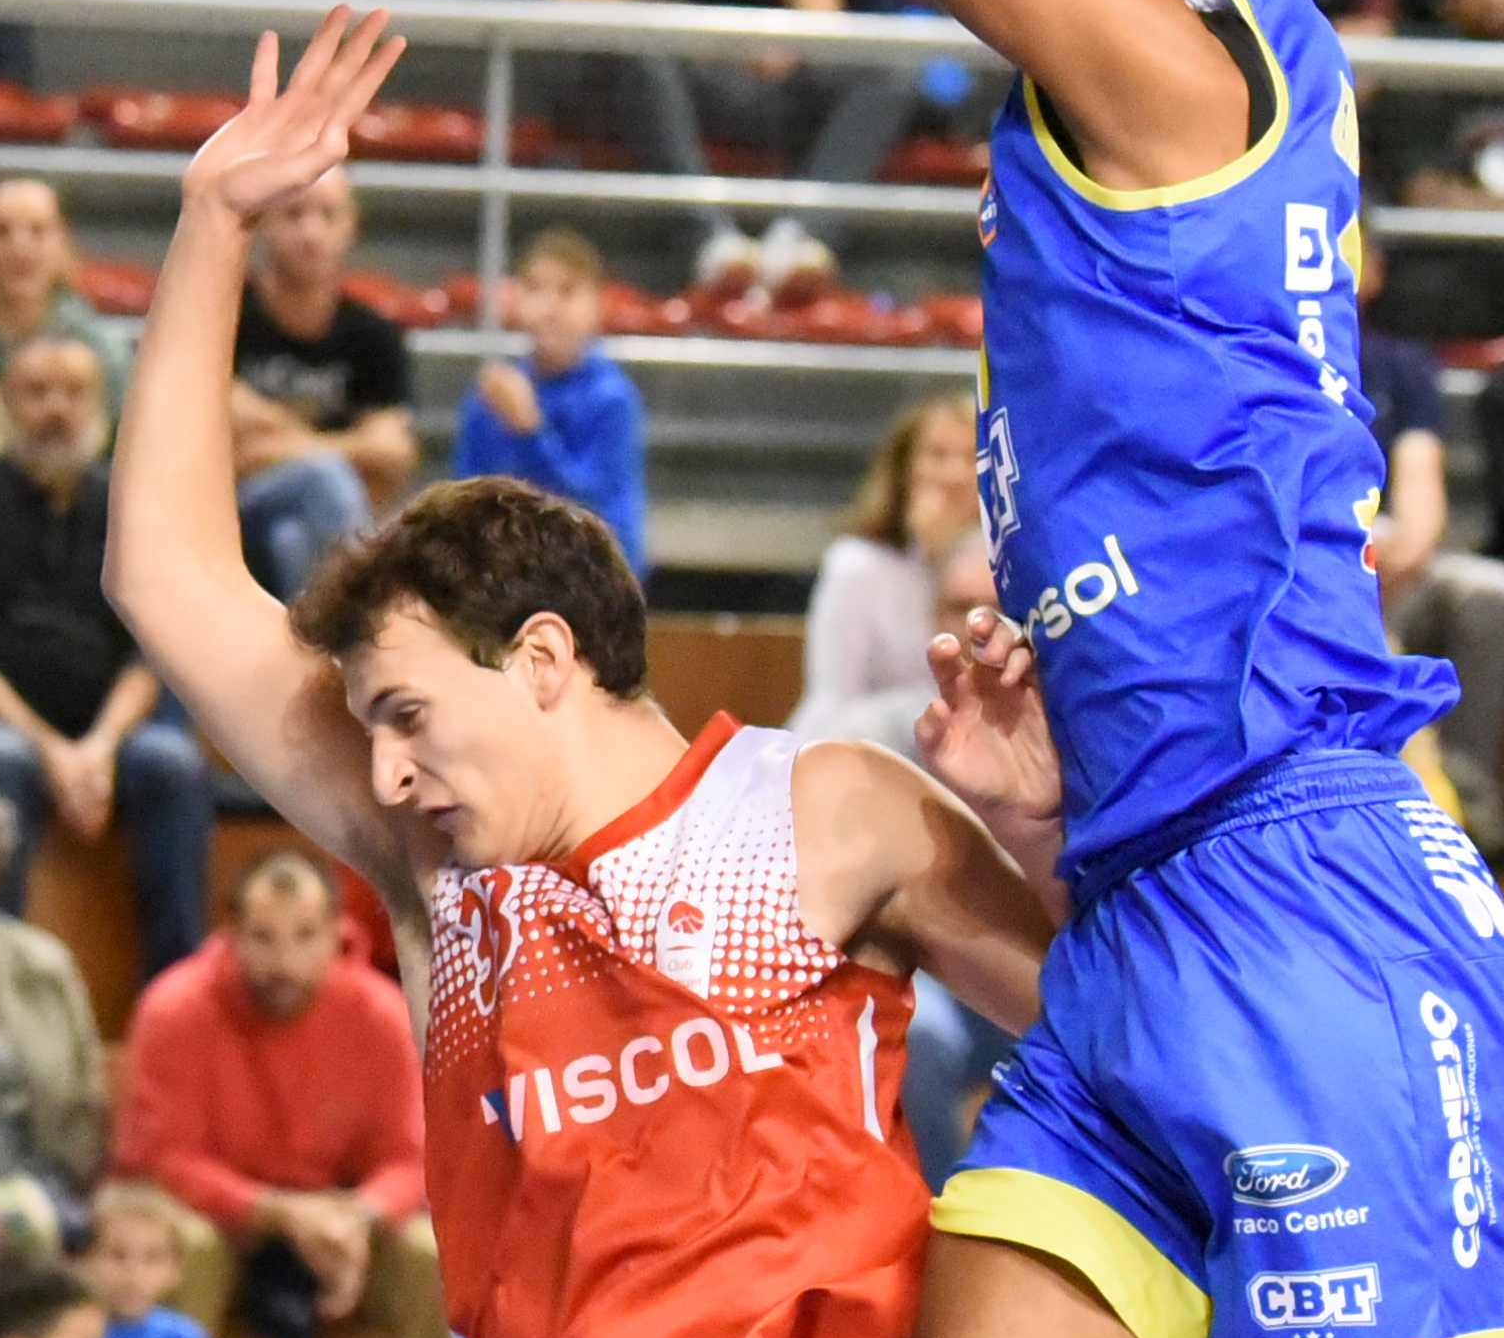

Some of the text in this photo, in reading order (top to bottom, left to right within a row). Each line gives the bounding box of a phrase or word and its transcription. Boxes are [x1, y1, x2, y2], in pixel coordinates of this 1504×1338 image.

[1420, 990, 1485, 1269] CORNEJO
[1236, 1158, 1311, 1193] Ford
[1285, 1206, 1369, 1234] Center
[1249, 1267, 1378, 1326] CBT
